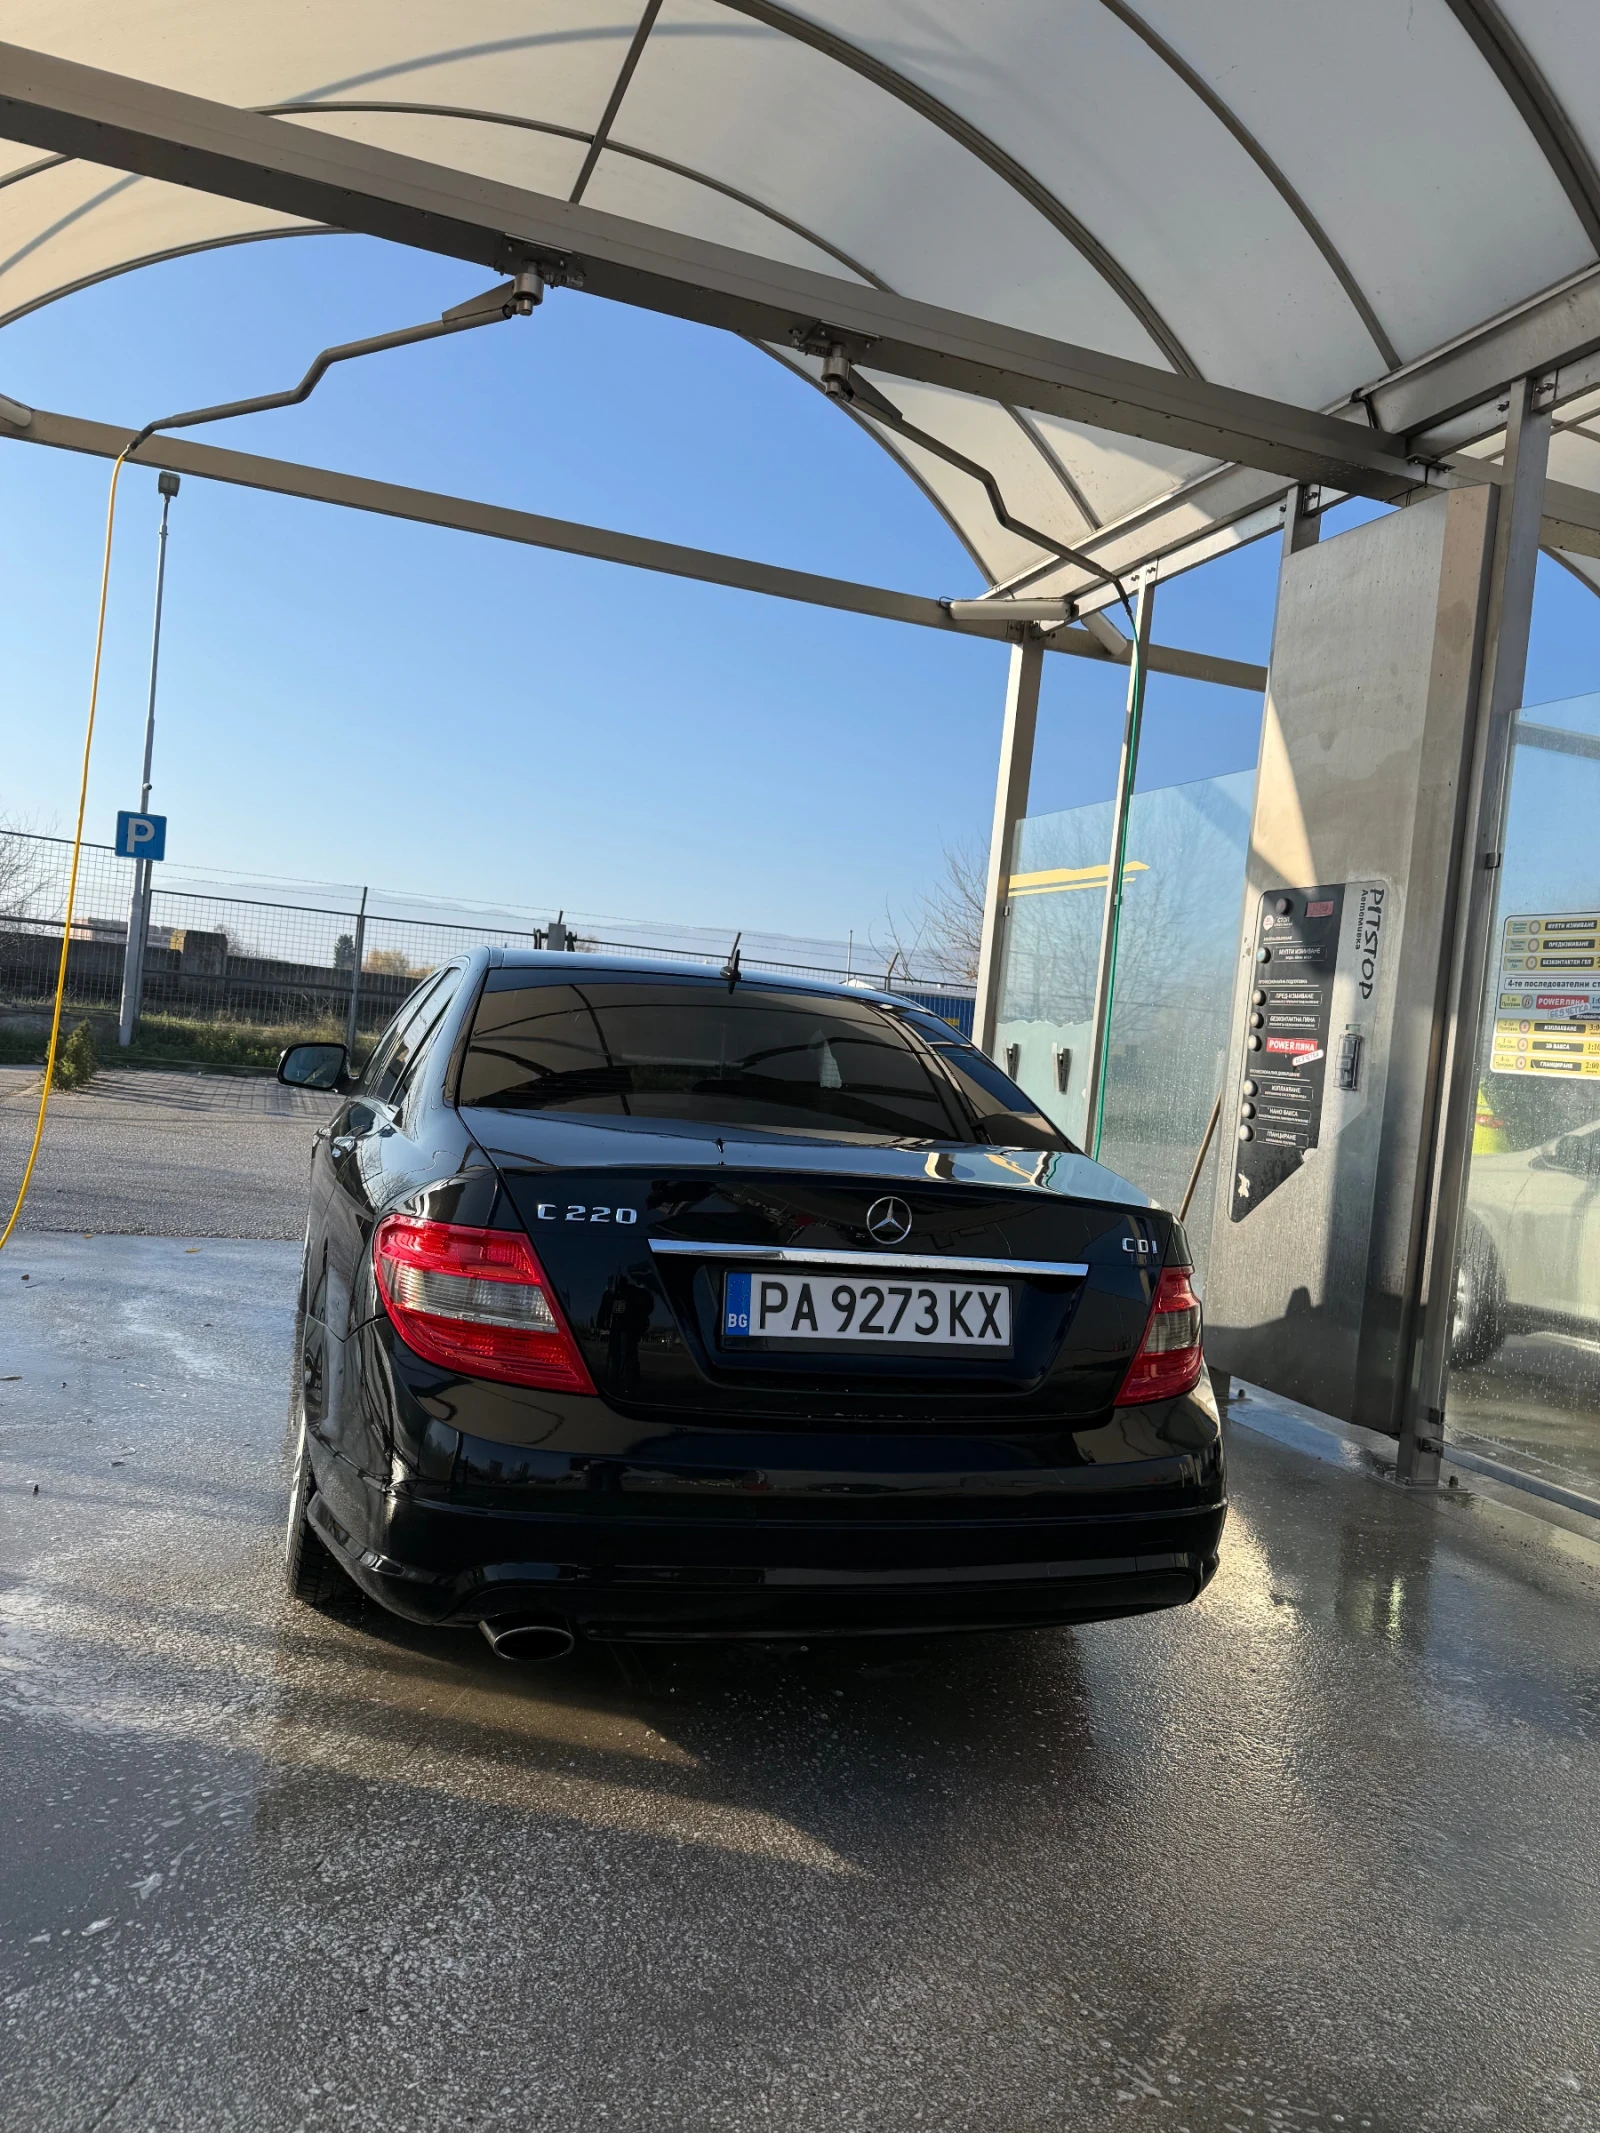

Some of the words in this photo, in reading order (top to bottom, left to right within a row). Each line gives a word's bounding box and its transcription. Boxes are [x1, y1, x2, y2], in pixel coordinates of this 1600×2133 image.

[127, 818, 155, 852] P
[1359, 889, 1384, 999] PITSTOP
[1550, 1010, 1565, 1018] БЕЗ
[1566, 1004, 1589, 1015] ЧЕТКА
[1269, 1040, 1294, 1050] POWER
[1295, 1043, 1315, 1051] ПЯНА
[537, 1203, 557, 1220] C
[565, 1205, 638, 1225] 220
[1121, 1237, 1158, 1255] CDI
[728, 1313, 748, 1329] BG
